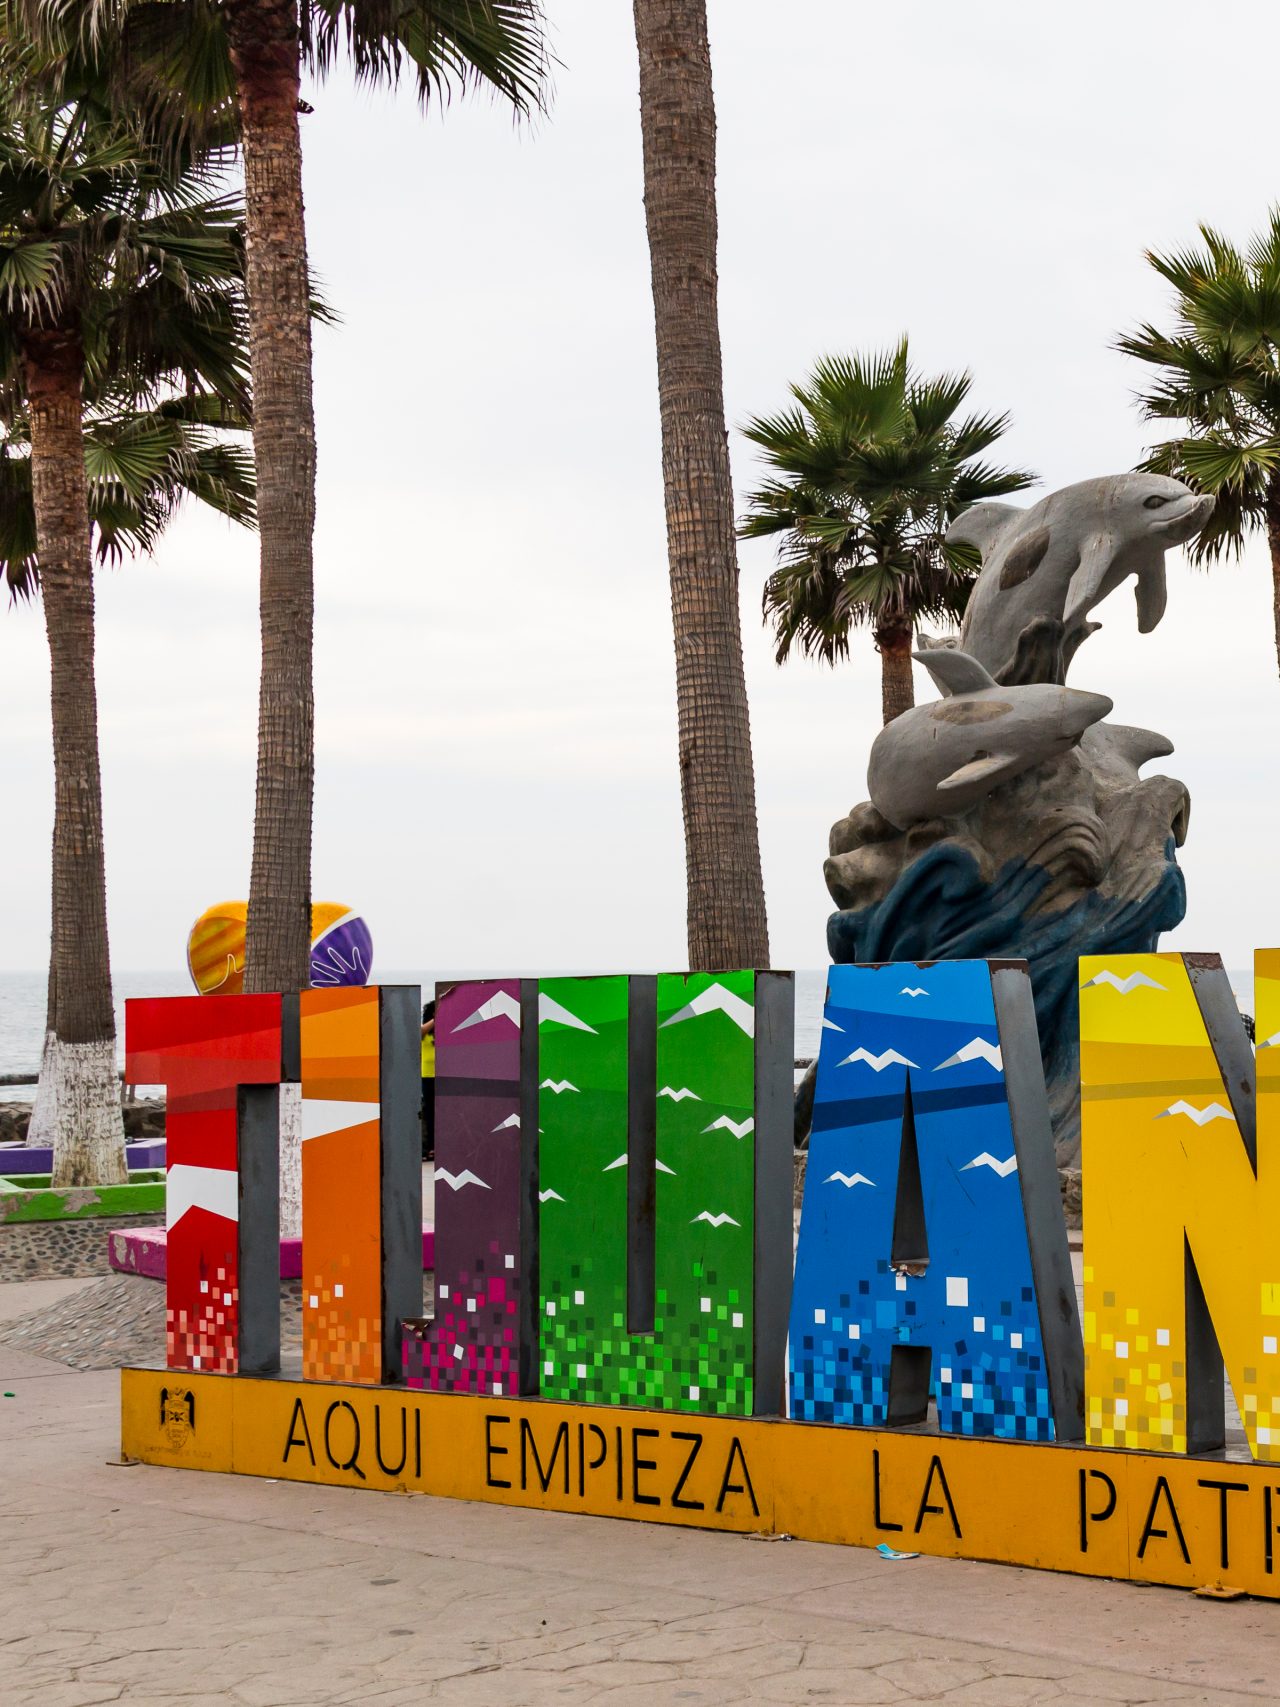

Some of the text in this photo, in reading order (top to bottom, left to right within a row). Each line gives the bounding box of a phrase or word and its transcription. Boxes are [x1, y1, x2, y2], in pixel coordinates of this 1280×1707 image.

[281, 1397, 422, 1480] AQUI
[485, 1414, 761, 1518] EMPIEZA
[872, 1449, 963, 1539] LA
